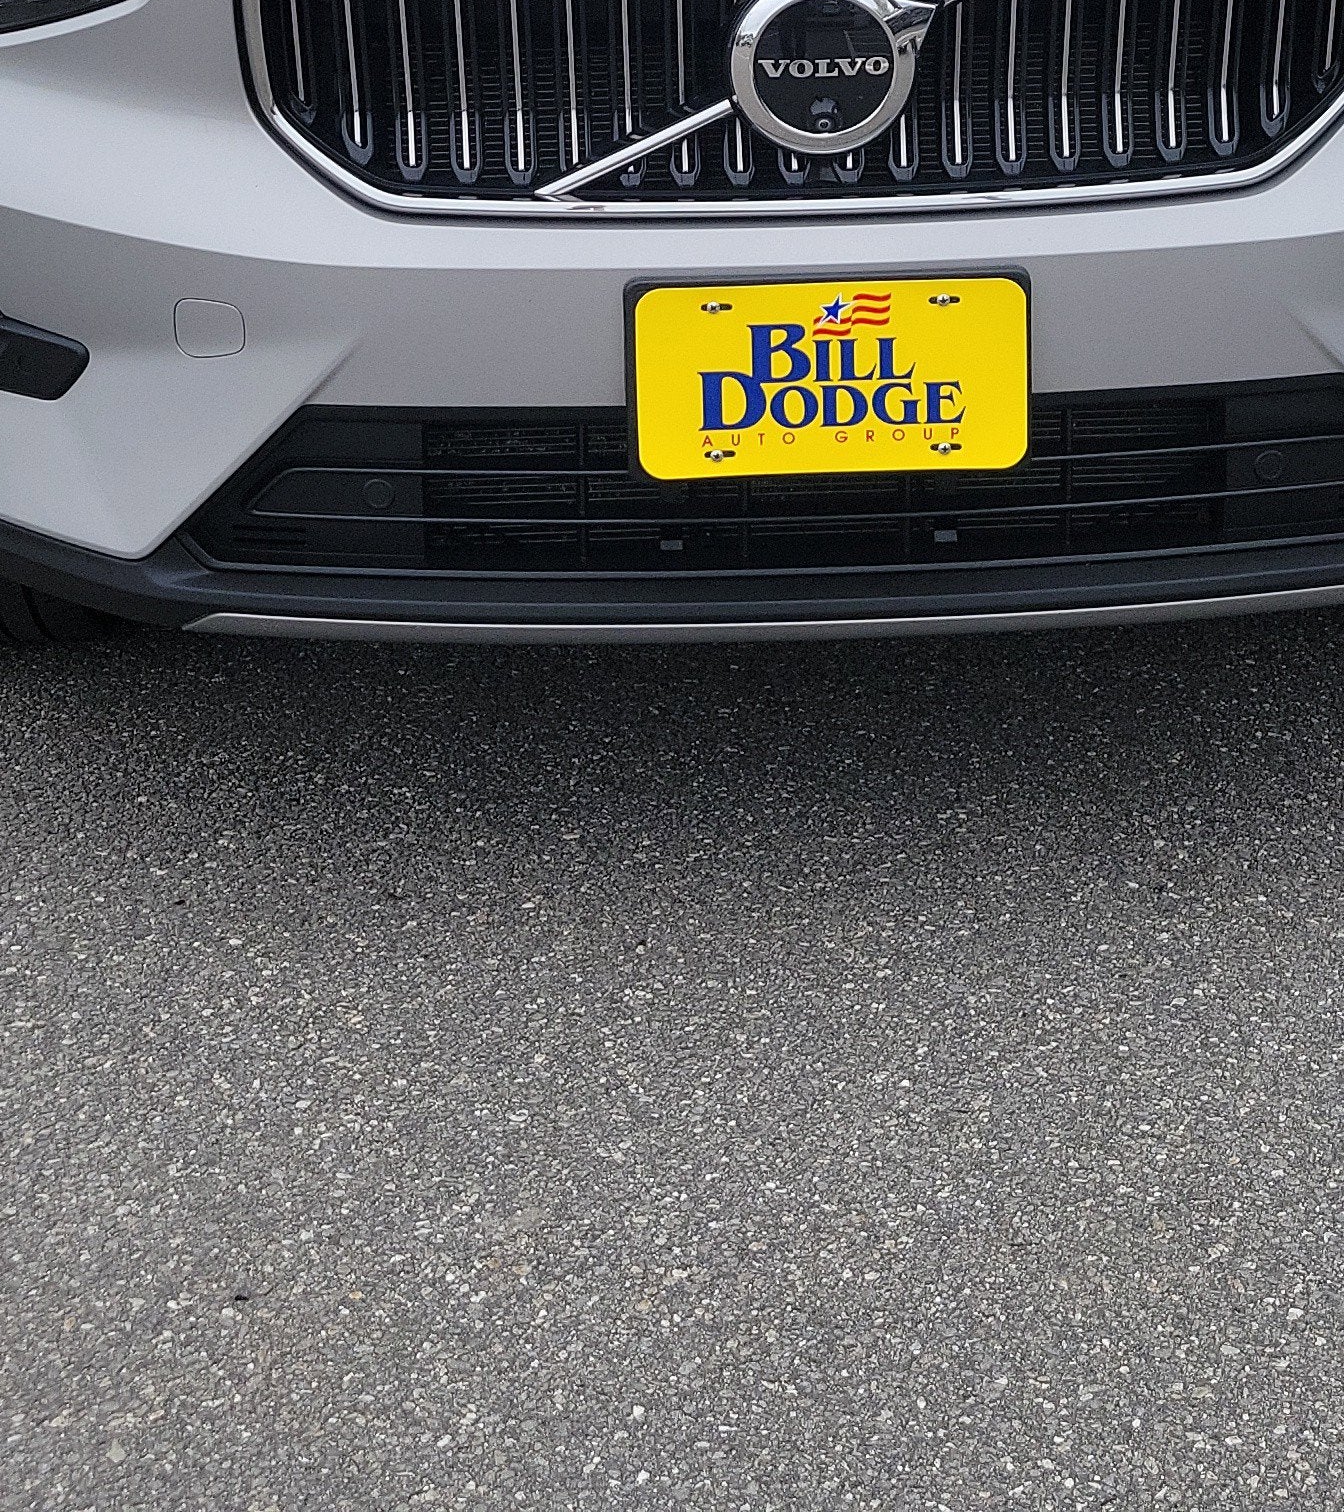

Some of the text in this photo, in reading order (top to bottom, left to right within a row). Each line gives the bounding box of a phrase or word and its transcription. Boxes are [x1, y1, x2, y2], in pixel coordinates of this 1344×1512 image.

[758, 56, 890, 78] VOLVO
[746, 323, 917, 384] BILL
[697, 371, 967, 432] DODGE
[702, 427, 960, 448] AUTO GROUP
